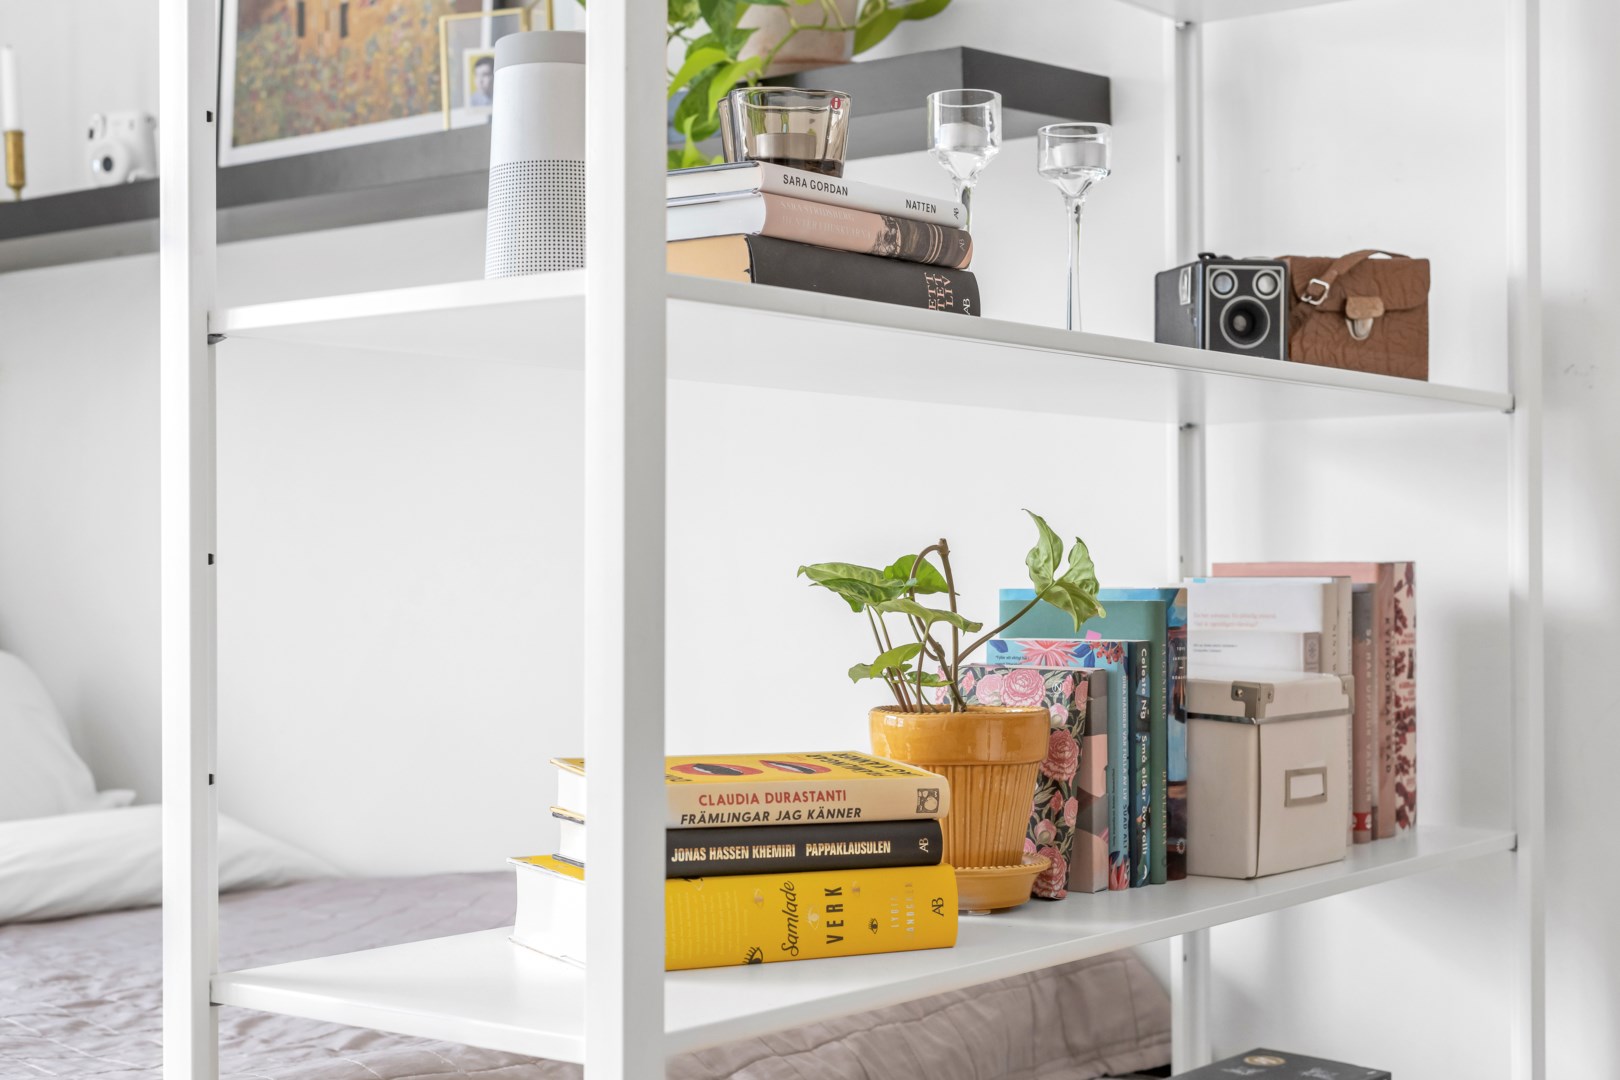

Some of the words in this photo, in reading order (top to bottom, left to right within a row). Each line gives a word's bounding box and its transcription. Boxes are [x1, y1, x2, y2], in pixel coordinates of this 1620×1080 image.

[783, 174, 807, 189] SARA
[810, 179, 849, 197] GORDAN
[905, 199, 937, 214] NATTEN
[923, 271, 936, 310] ETT
[941, 275, 954, 307] LIV
[1122, 775, 1127, 786] AV
[698, 792, 760, 806] CLAUDIA
[764, 789, 847, 805] DURASTANTI
[680, 811, 770, 825] FRÄMLINGAR
[775, 809, 802, 821] JAG
[807, 806, 862, 821] KÄNNER
[671, 847, 707, 862] JONAS
[709, 845, 749, 860] HASSEN
[752, 844, 796, 859] KHEMIRI
[805, 840, 891, 856] PAPPAKLAUSULEN
[779, 880, 800, 957] Samlade
[824, 886, 844, 945] VERK
